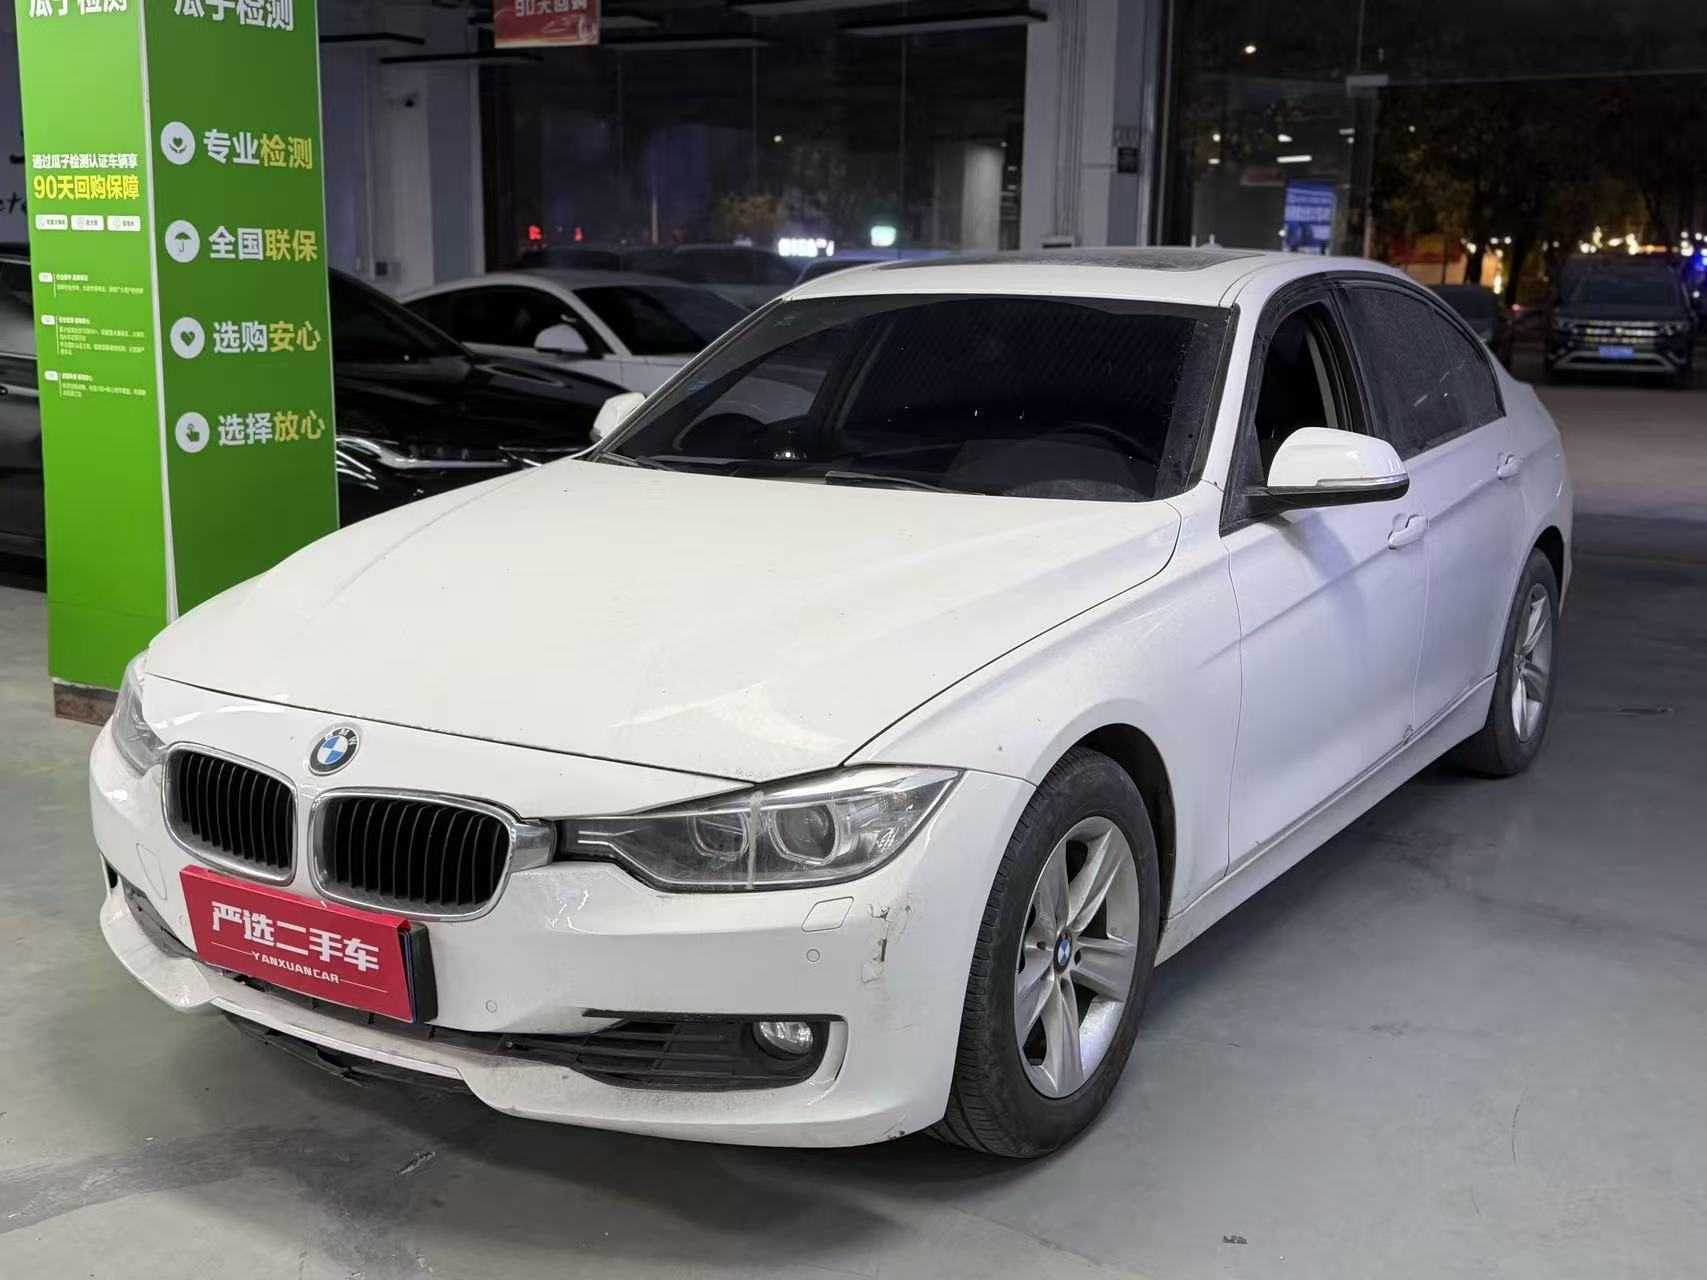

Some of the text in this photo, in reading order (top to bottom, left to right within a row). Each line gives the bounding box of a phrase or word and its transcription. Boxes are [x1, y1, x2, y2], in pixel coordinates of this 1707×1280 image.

[174, 0, 294, 31] 瓜子检测
[32, 153, 138, 169] 通过瓜子检测认证车辆享
[203, 128, 313, 170] 专业检测
[33, 174, 140, 200] 90天回购保障
[208, 225, 318, 263] 全国联保
[213, 320, 321, 353] 选购安心
[218, 409, 325, 447] 选择放心
[211, 901, 380, 971] 严选二手车
[252, 951, 340, 984] YANXUANCAR
